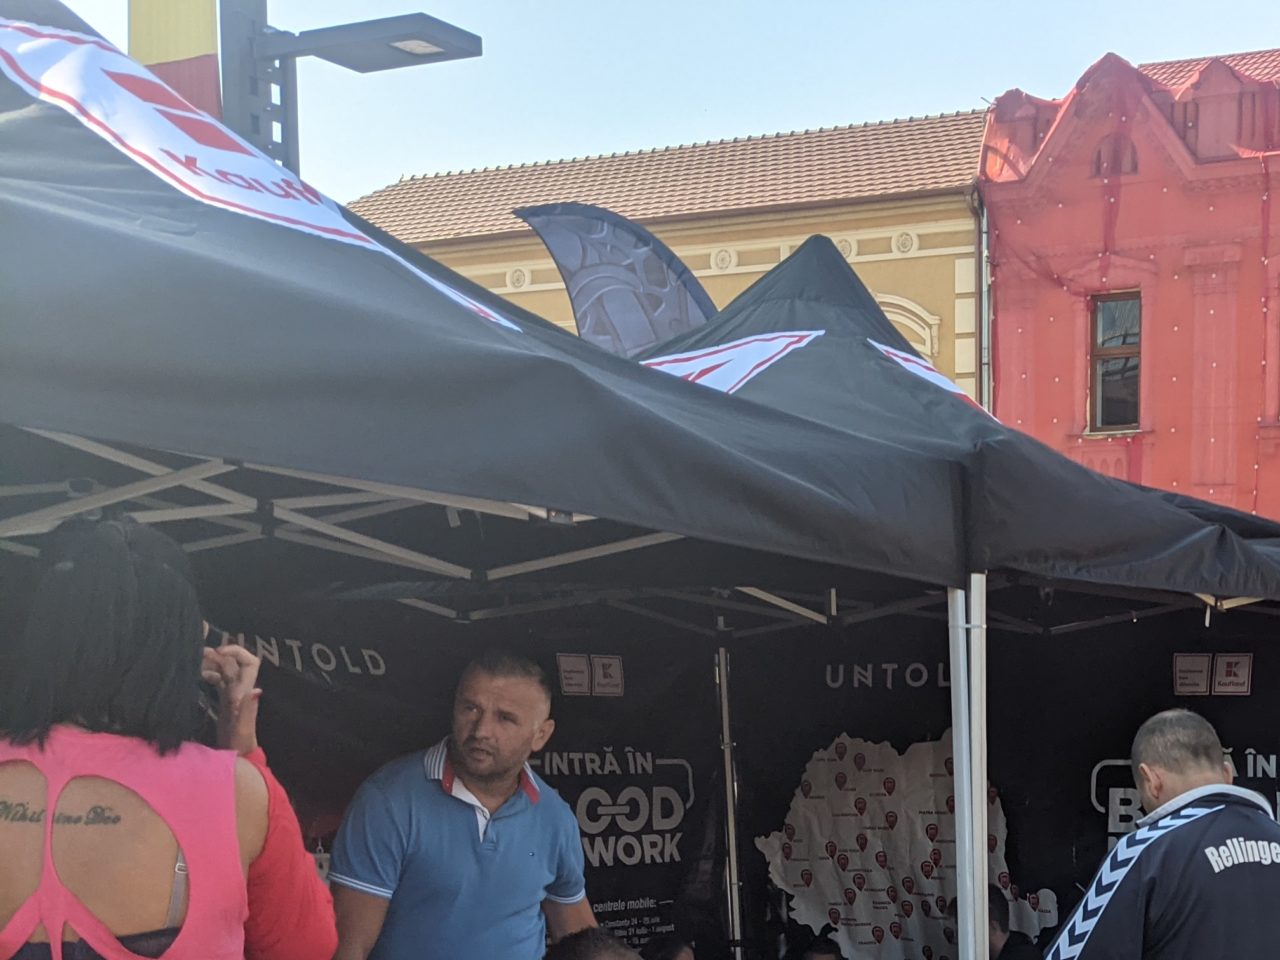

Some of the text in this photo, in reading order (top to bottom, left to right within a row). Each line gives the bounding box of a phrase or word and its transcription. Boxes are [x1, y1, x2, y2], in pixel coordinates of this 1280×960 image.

[826, 662, 951, 690] UNTOL
[544, 746, 653, 776] INTRĂ ÎN
[576, 786, 685, 835] OOD
[582, 832, 684, 868] WORK
